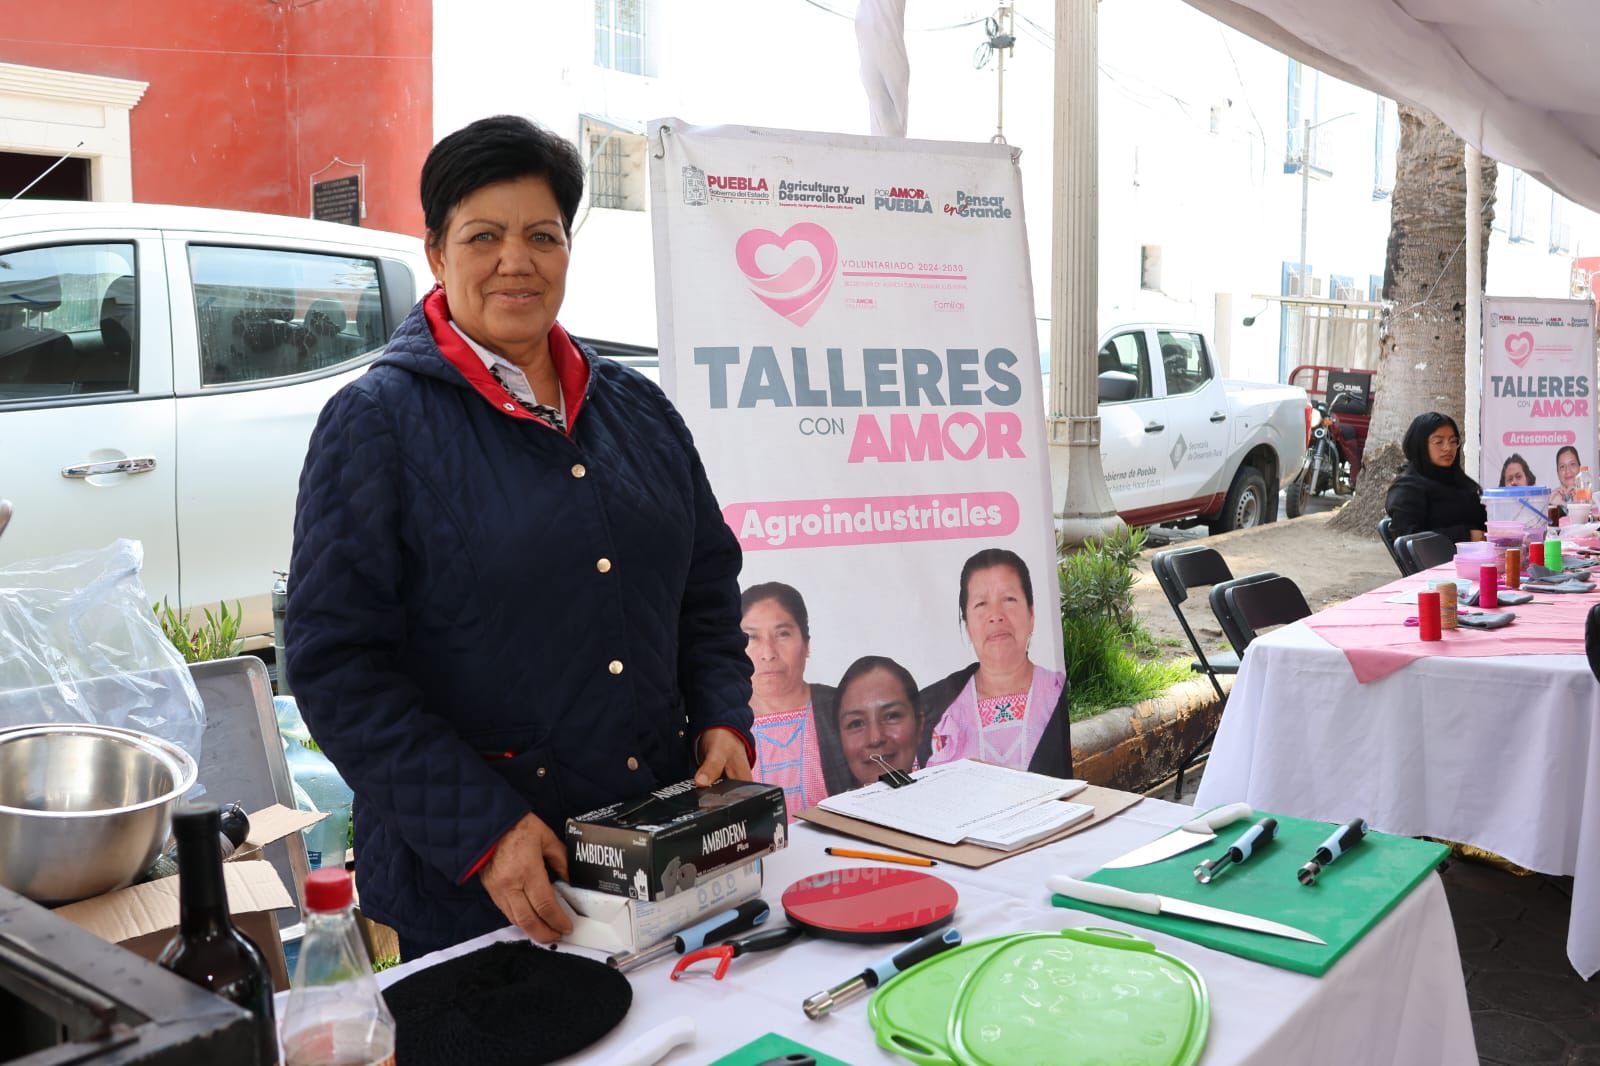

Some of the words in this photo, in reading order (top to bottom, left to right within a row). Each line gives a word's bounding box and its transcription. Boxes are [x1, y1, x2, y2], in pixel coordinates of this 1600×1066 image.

[707, 175, 769, 192] PUEBLA
[778, 180, 841, 195] Agricultura
[842, 185, 850, 196] y
[708, 189, 736, 198] Gobierno
[747, 191, 770, 199] Estado
[778, 190, 835, 204] Desarrollo
[837, 194, 865, 205] Rural
[889, 187, 925, 199] AMOR
[956, 190, 1005, 207] Pensar
[874, 197, 933, 214] PUEBLA
[959, 205, 1012, 219] Grande
[841, 259, 914, 270] VOLUNTARIADO
[918, 262, 964, 272] 2024-2030
[693, 346, 1022, 409] TALLERES
[1491, 375, 1590, 398] TALLERES
[1517, 400, 1530, 408] CON
[1530, 399, 1589, 418] AMOR
[798, 417, 845, 436] CON
[848, 411, 1026, 464] AMOR
[1509, 432, 1569, 445] Artesanales
[1103, 470, 1127, 481] obierno
[739, 498, 1002, 546] Agroindustriales
[701, 821, 747, 856] AMBIDERM
[575, 841, 624, 869] AMBIDERM
[736, 842, 750, 853] Plus
[613, 869, 628, 880] Plus
